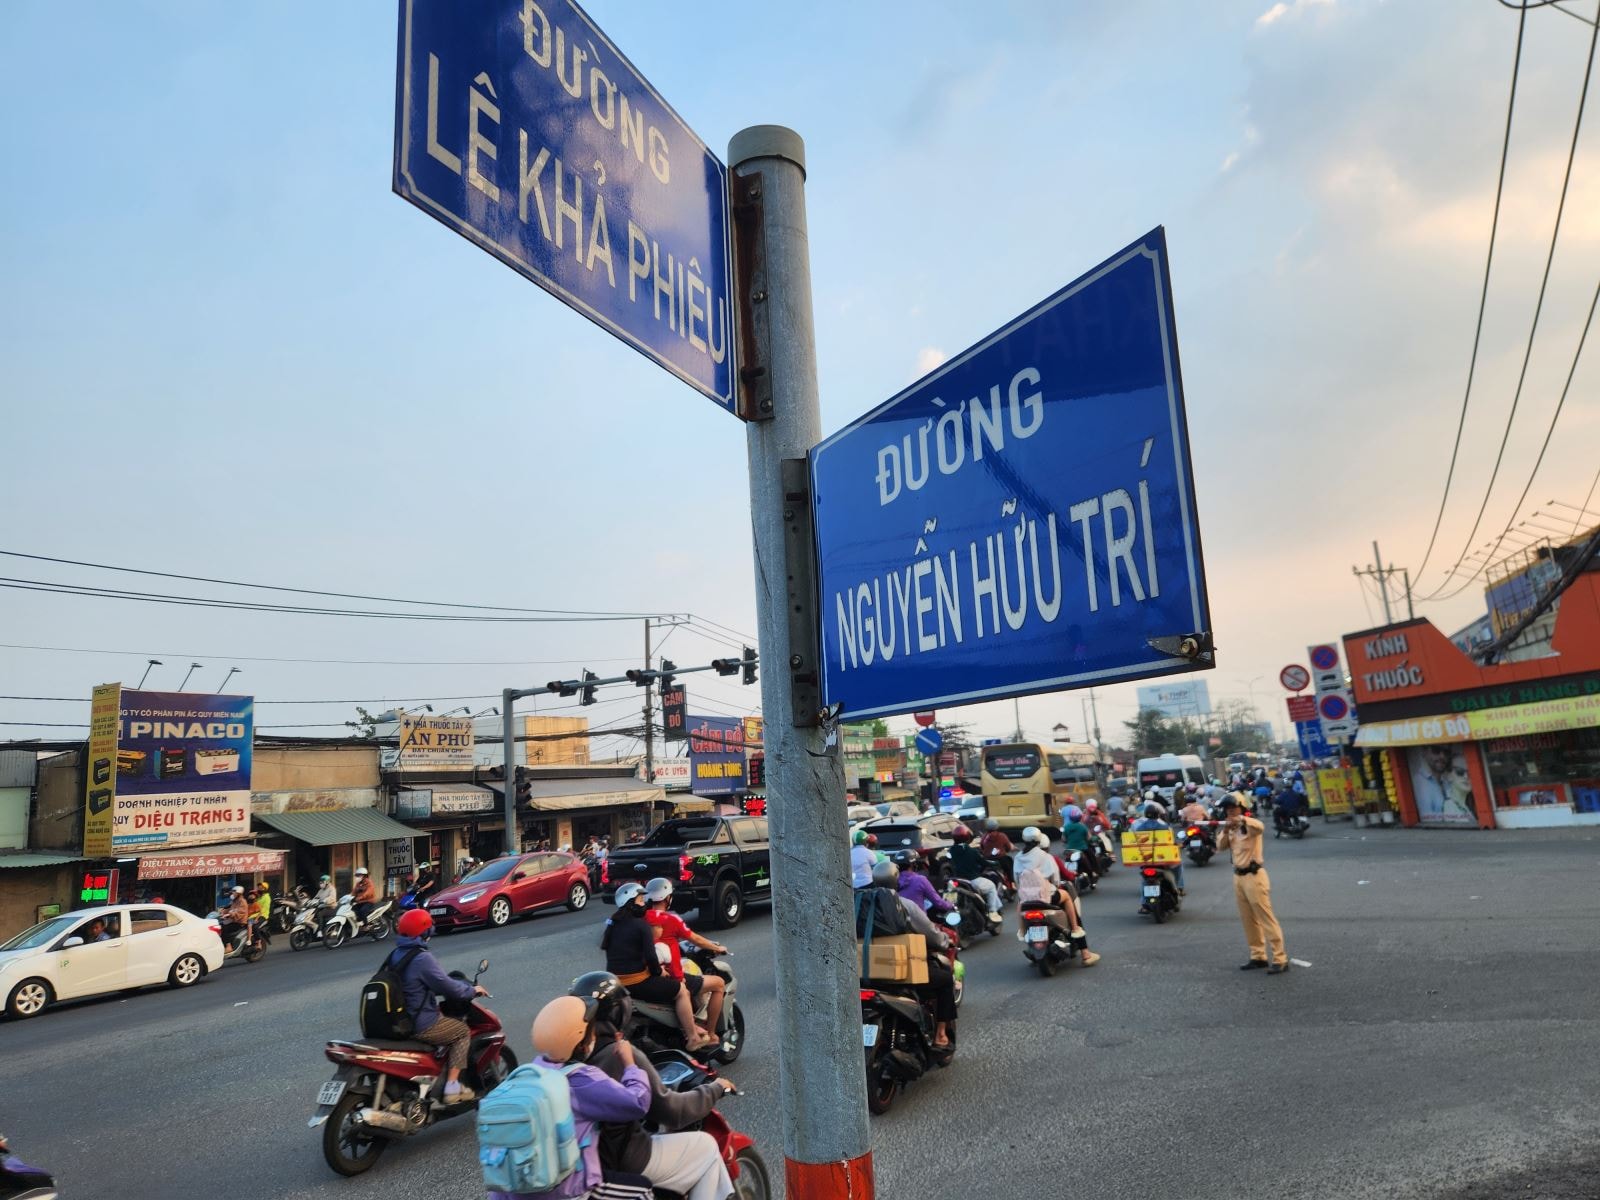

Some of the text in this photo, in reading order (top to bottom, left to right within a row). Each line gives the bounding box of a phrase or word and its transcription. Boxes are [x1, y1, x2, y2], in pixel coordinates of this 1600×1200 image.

[519, 0, 670, 185] ĐƯỜNG
[427, 52, 726, 364] LÊ KHẢ PHIÊU
[876, 367, 1043, 506] ĐƯỜNG
[836, 438, 1159, 672] NGUYỄN HỮU TRÍ
[1364, 633, 1407, 660] KÍNH
[1362, 659, 1423, 692] THUỐC
[130, 721, 245, 739] PINACO
[437, 730, 470, 747] PHÚ
[118, 799, 151, 808] DOANH
[155, 797, 188, 808] NGHIỆP
[204, 795, 227, 805] NHÂN
[134, 810, 175, 831] DIỆU
[179, 808, 232, 826] TRANG
[236, 808, 245, 821] 3
[164, 857, 193, 866] TRANG
[221, 856, 254, 865] QUY
